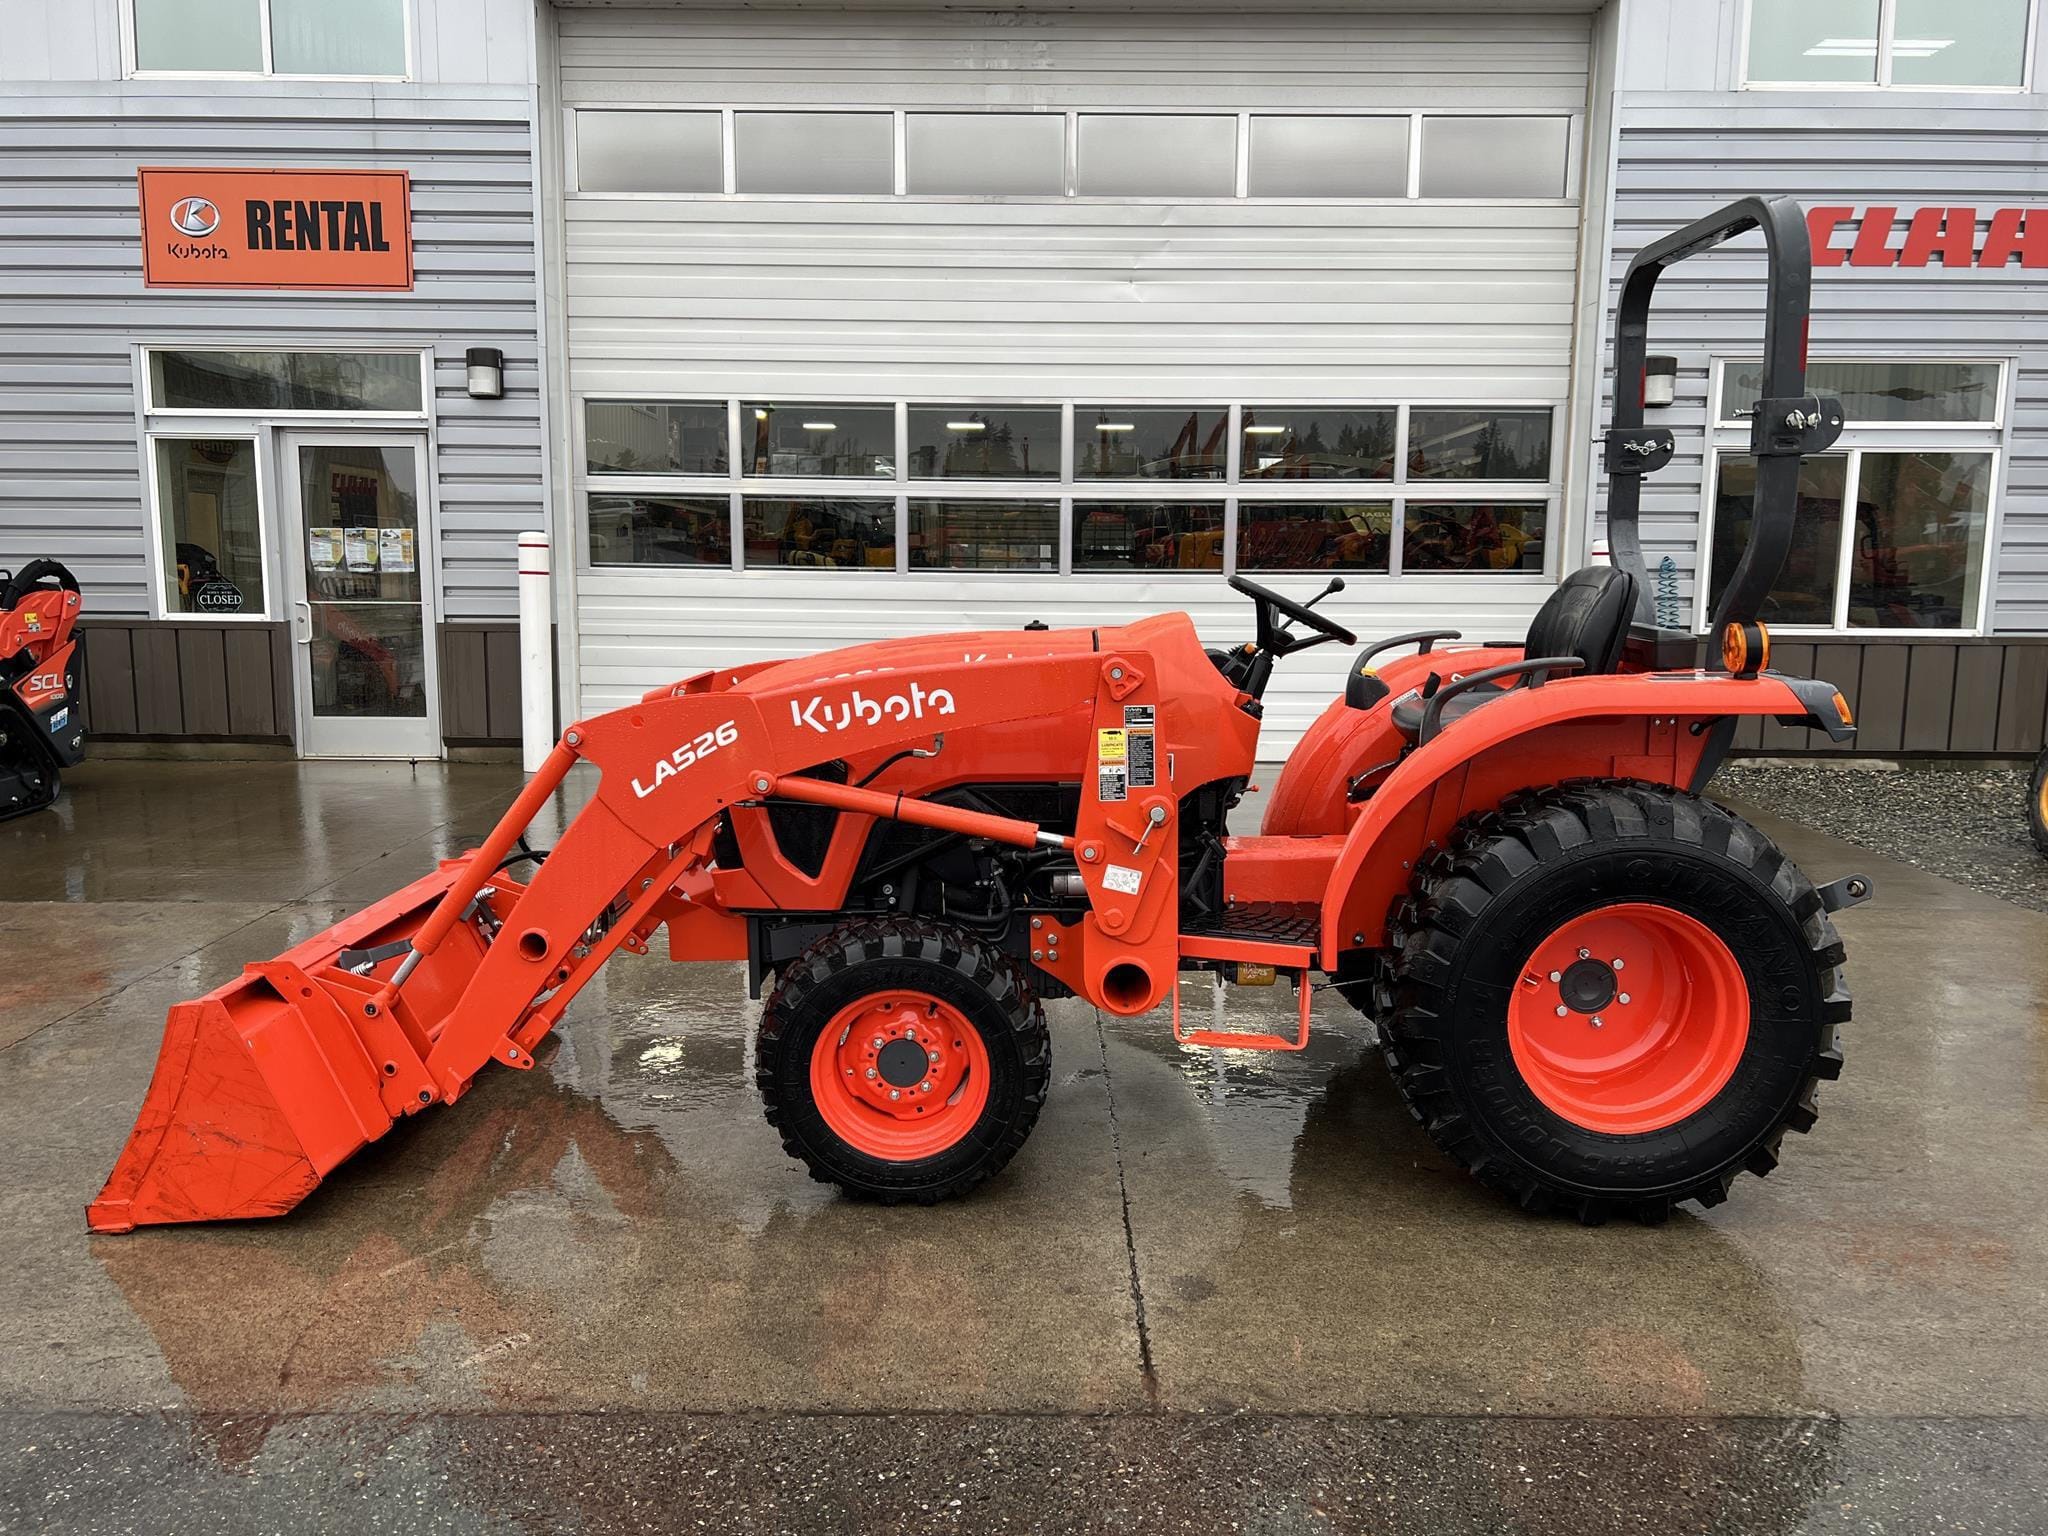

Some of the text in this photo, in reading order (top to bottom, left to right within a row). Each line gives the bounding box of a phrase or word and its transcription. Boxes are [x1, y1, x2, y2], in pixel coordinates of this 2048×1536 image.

[246, 200, 390, 251] RENTAL
[167, 243, 228, 259] Kubota
[200, 594, 242, 605] CLOSED
[29, 673, 64, 691] SCL
[790, 682, 956, 734] Kubota
[631, 719, 738, 798] LA526
